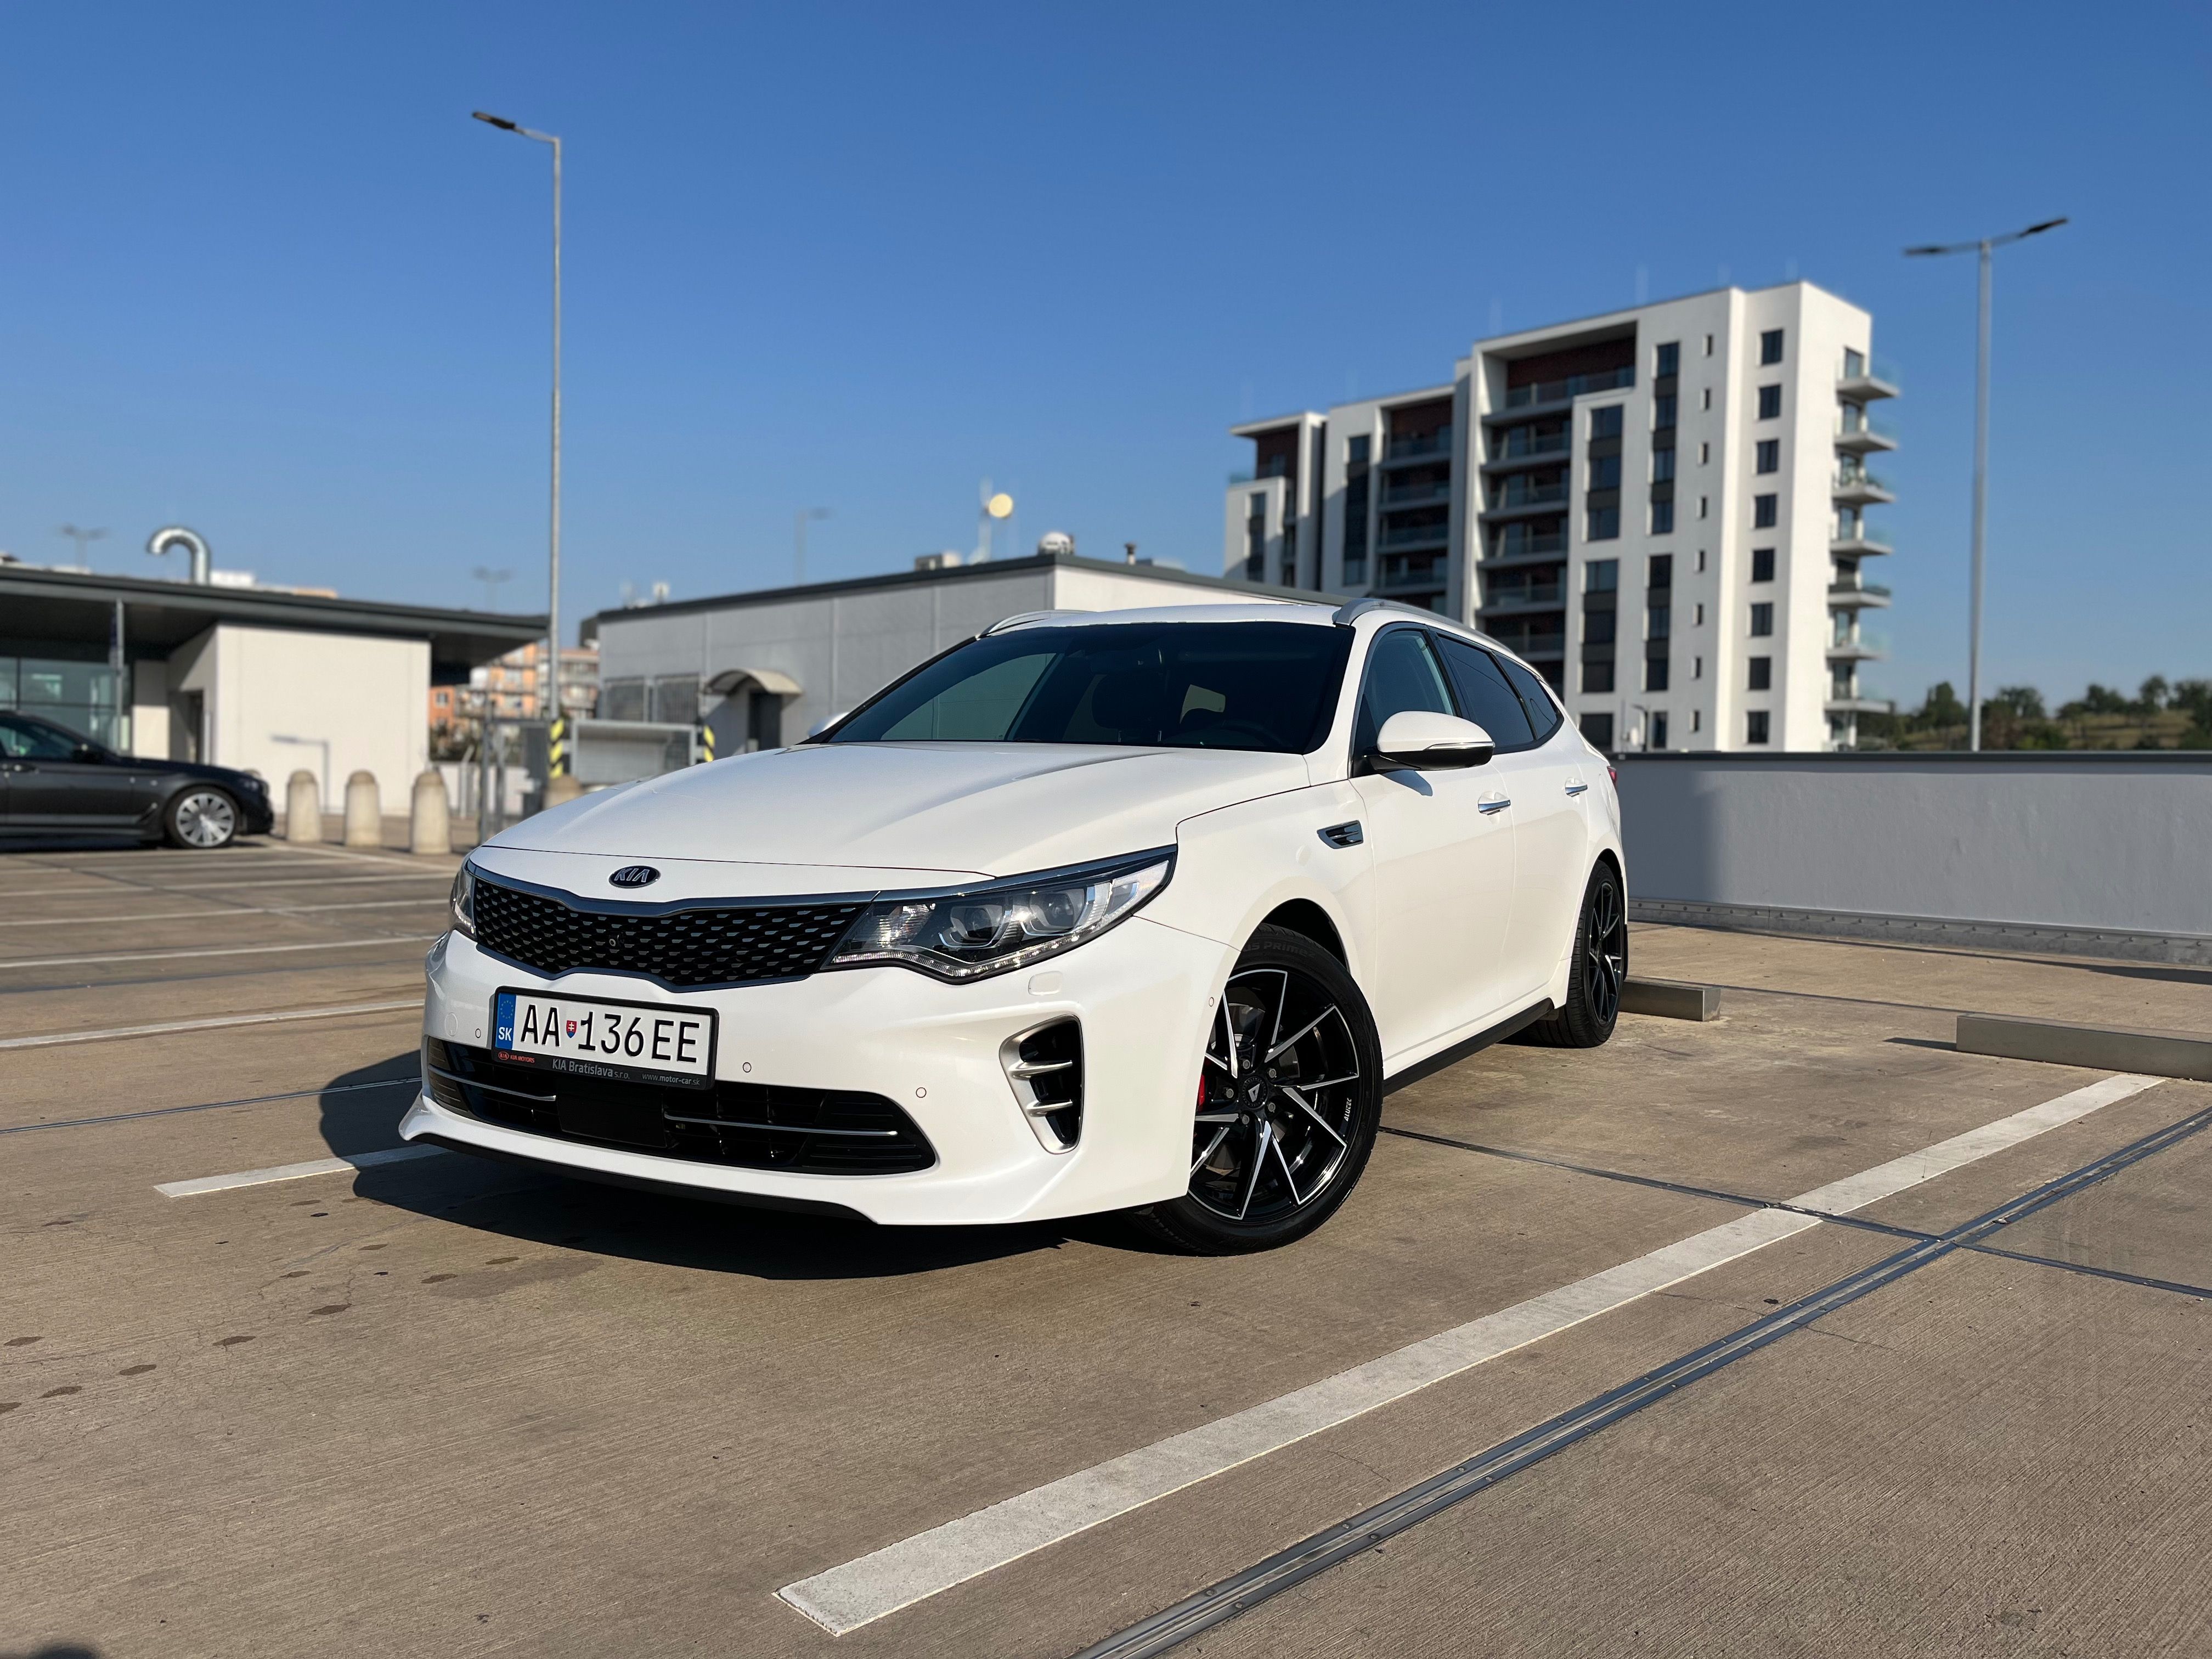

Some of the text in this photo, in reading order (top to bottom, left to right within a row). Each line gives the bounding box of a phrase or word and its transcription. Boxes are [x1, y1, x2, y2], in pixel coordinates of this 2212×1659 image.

[614, 868, 650, 882] KIA
[499, 1027, 512, 1041] SK
[552, 1058, 566, 1070] KIA
[569, 1061, 613, 1077] Bratislava
[642, 1073, 700, 1085] www.motor-car.sk
[1344, 1097, 1352, 1122] ALUTEC
